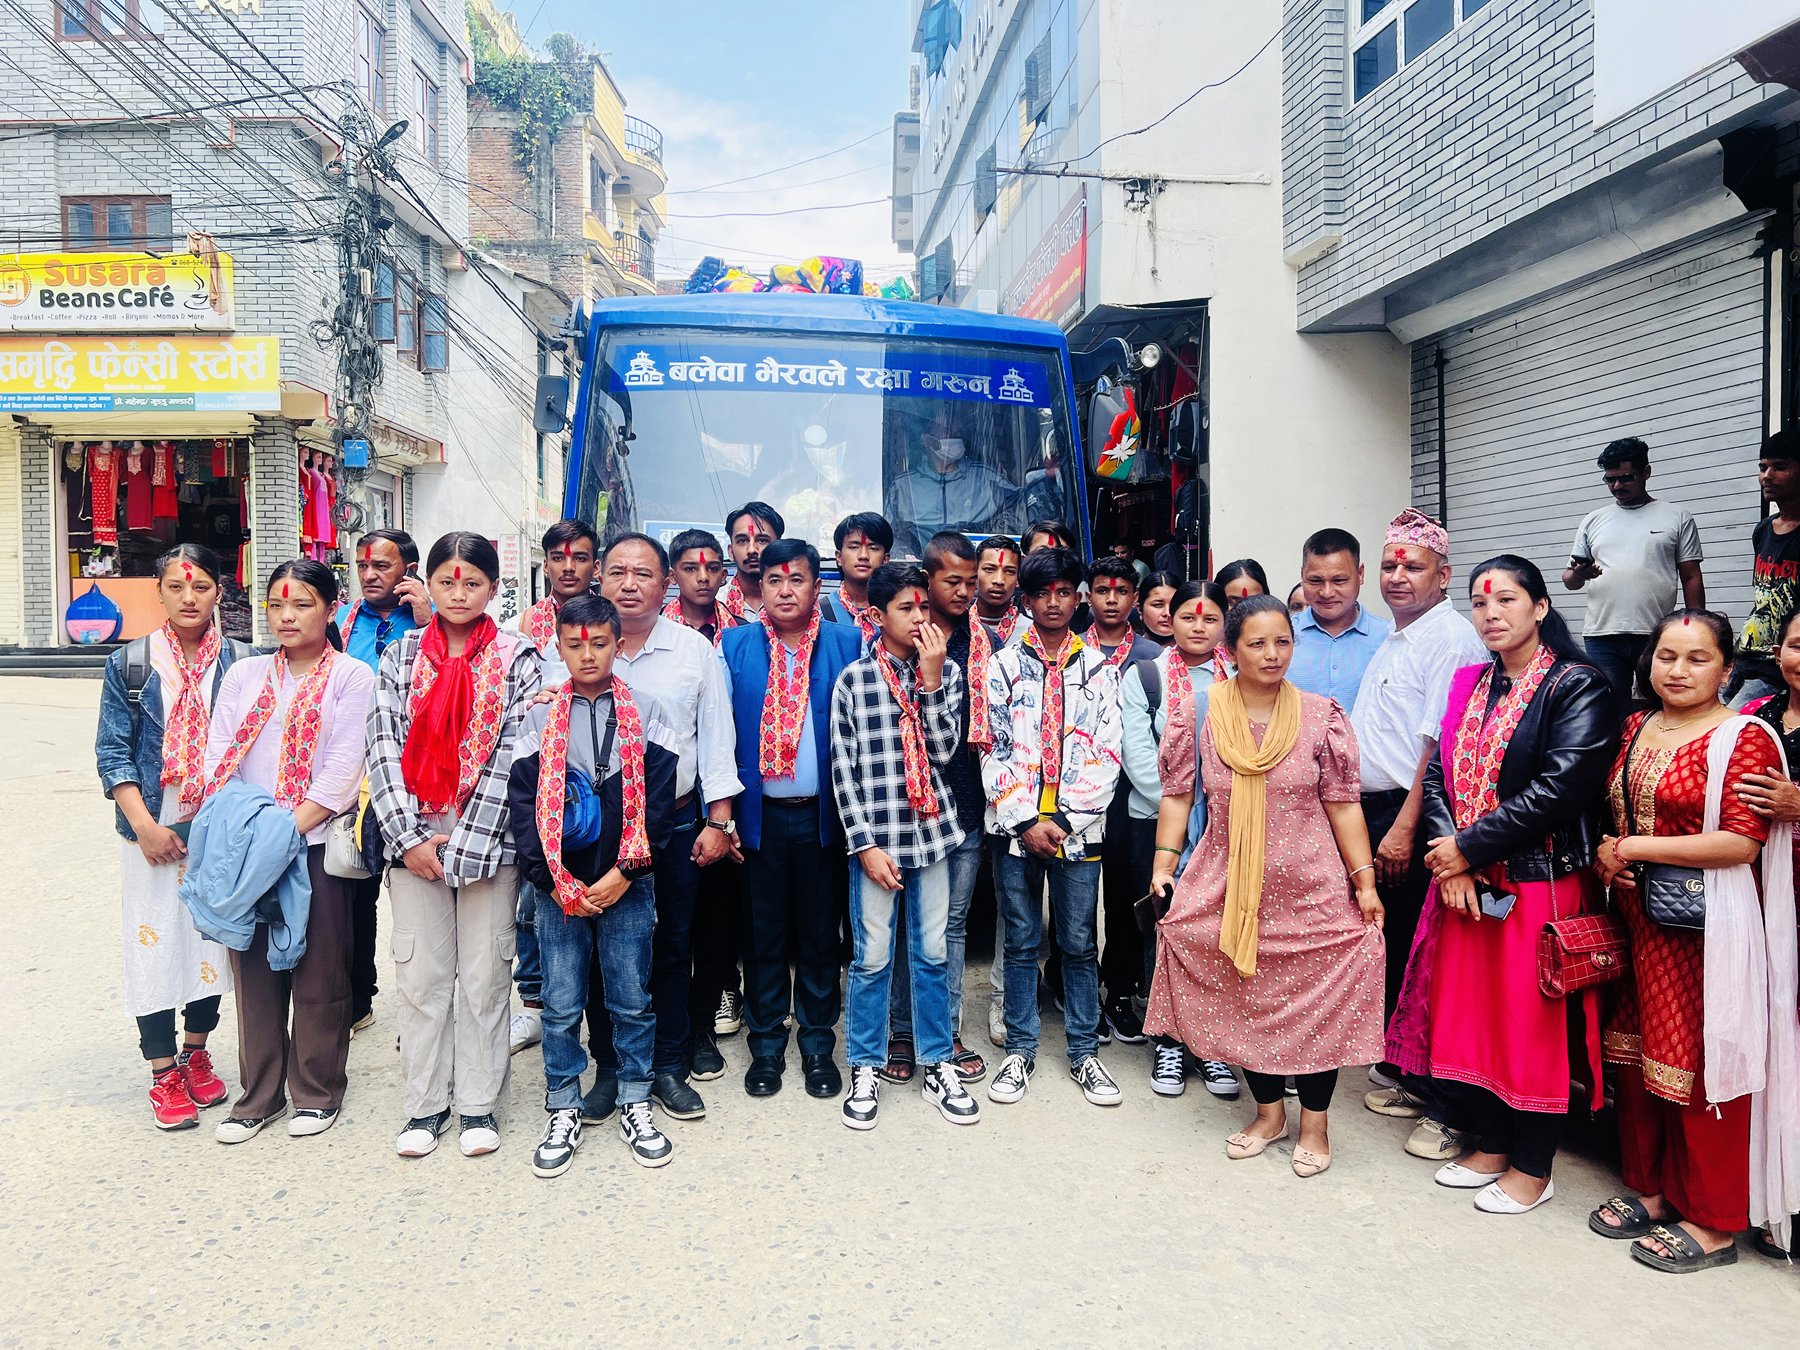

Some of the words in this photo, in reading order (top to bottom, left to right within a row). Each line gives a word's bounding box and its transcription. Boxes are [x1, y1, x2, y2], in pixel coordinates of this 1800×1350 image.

[44, 259, 166, 287] Susara
[40, 289, 115, 308] Beans
[118, 285, 174, 307] Café
[668, 355, 747, 383] बलेवा
[755, 356, 847, 387] भैरवले
[856, 367, 912, 391] रक्षा
